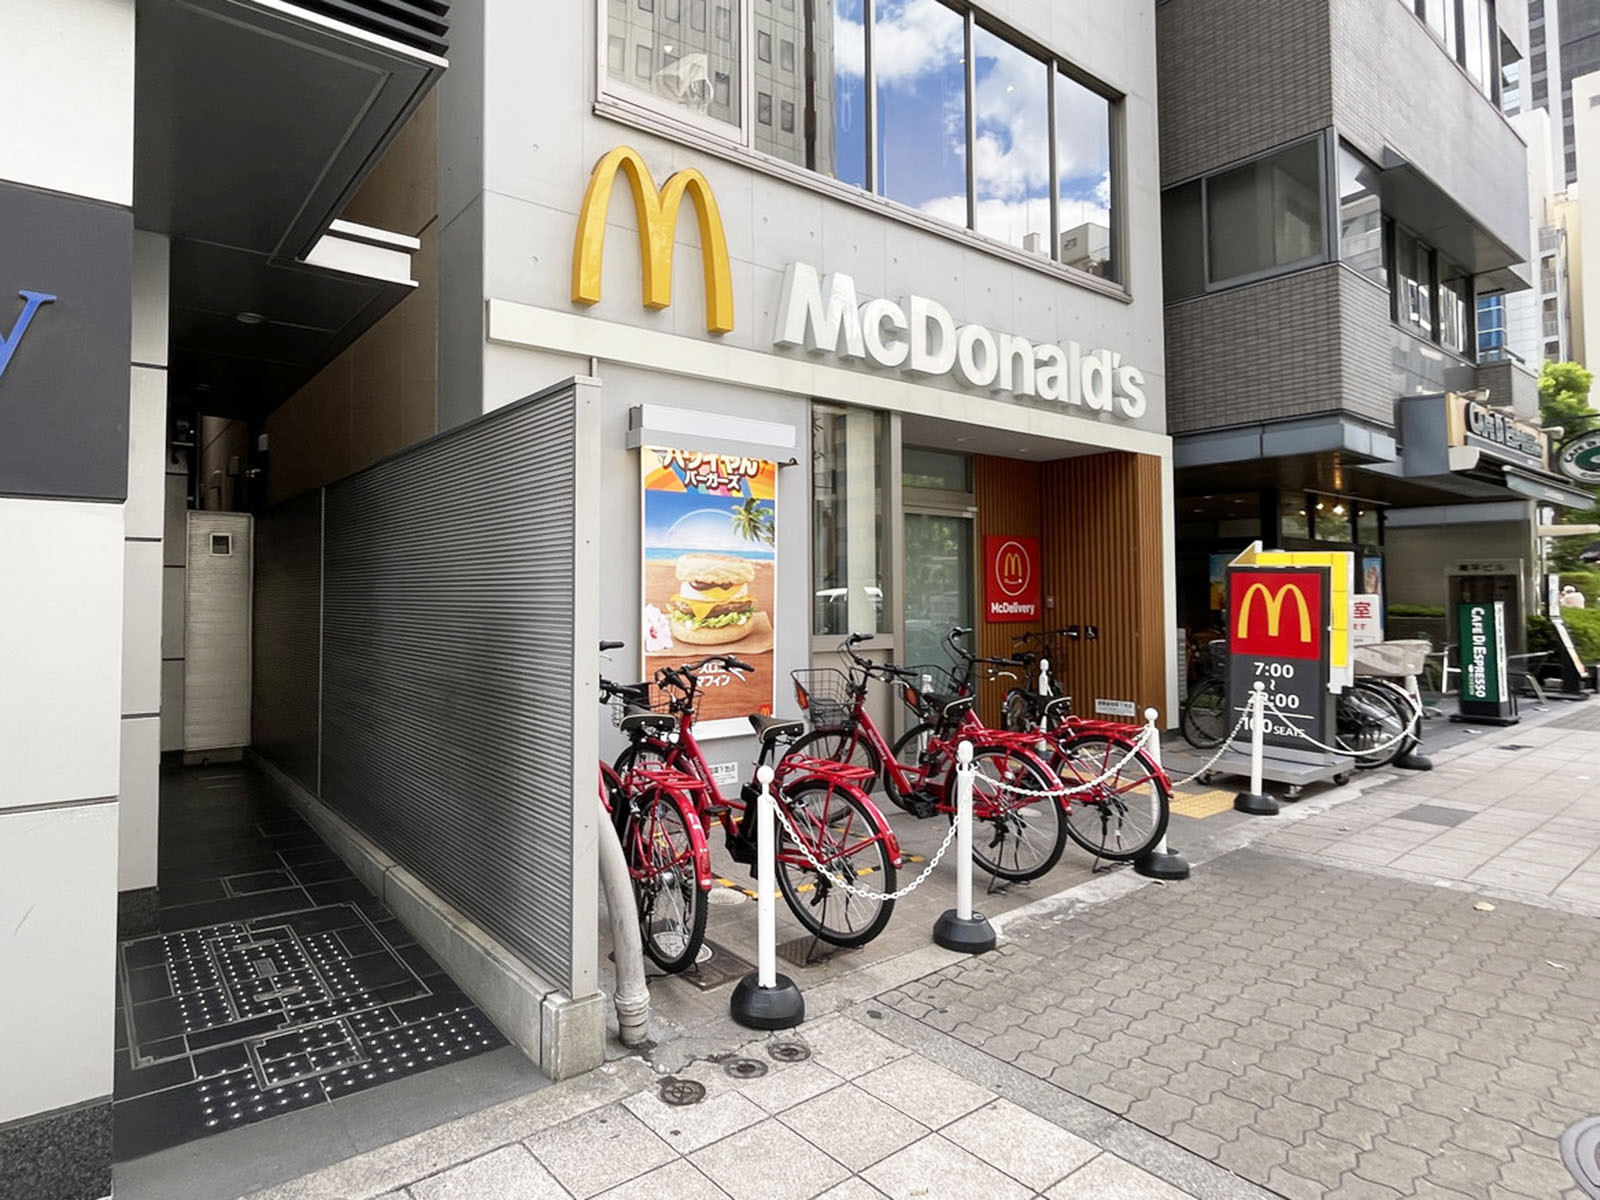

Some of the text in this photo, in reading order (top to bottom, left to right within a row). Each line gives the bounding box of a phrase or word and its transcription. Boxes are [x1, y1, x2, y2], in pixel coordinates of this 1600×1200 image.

[773, 261, 1147, 419] McDonald's
[685, 471, 741, 489] バーガーズ
[991, 602, 1035, 615] McDelivery
[1254, 662, 1294, 678] 7:00
[1473, 646, 1487, 698] ESPRESSO
